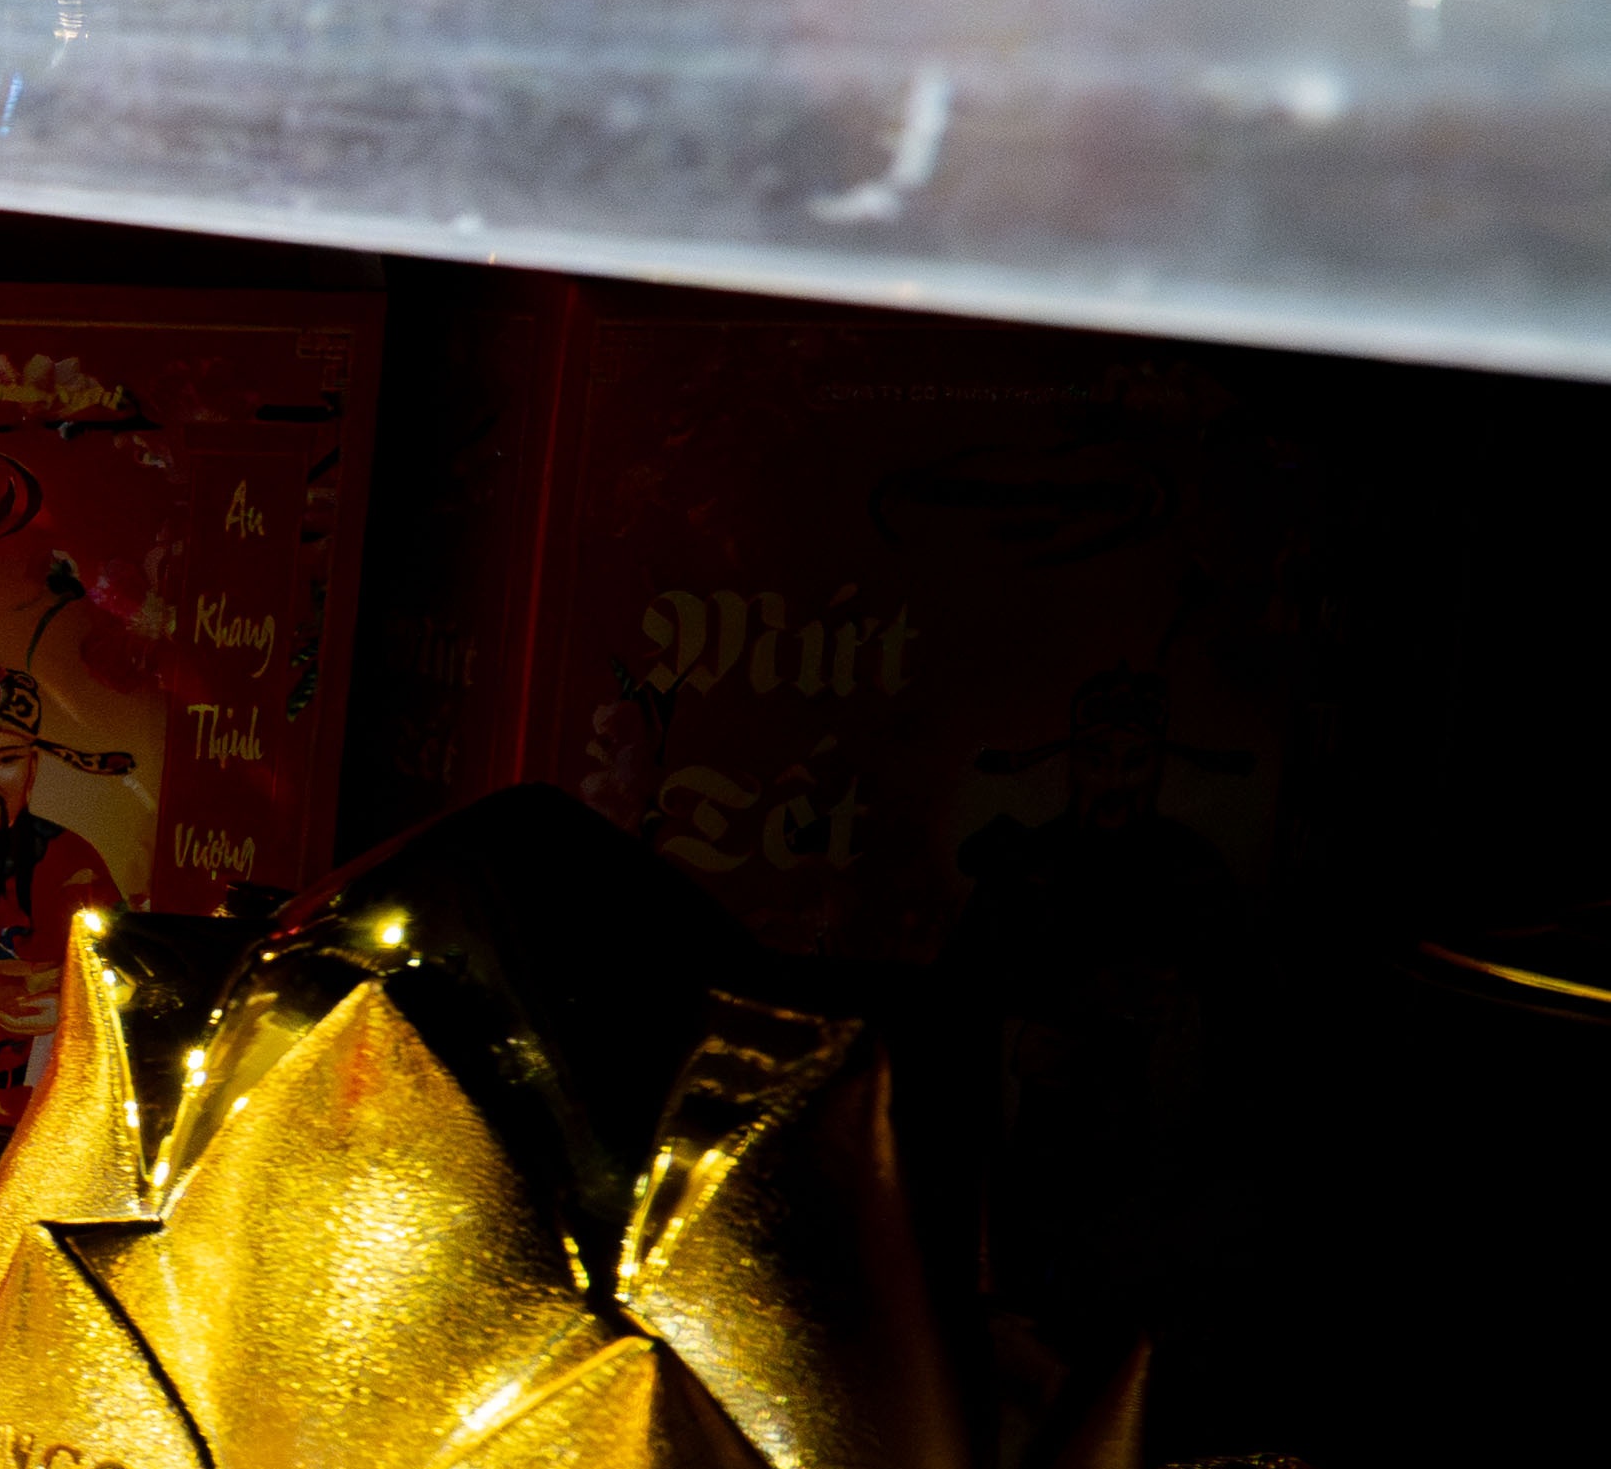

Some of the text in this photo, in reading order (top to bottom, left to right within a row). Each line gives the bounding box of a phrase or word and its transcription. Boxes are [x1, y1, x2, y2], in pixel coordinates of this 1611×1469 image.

[224, 479, 266, 539] An
[194, 592, 276, 679] Khang
[187, 703, 264, 770] Thịnh
[174, 823, 257, 881] Vượng
